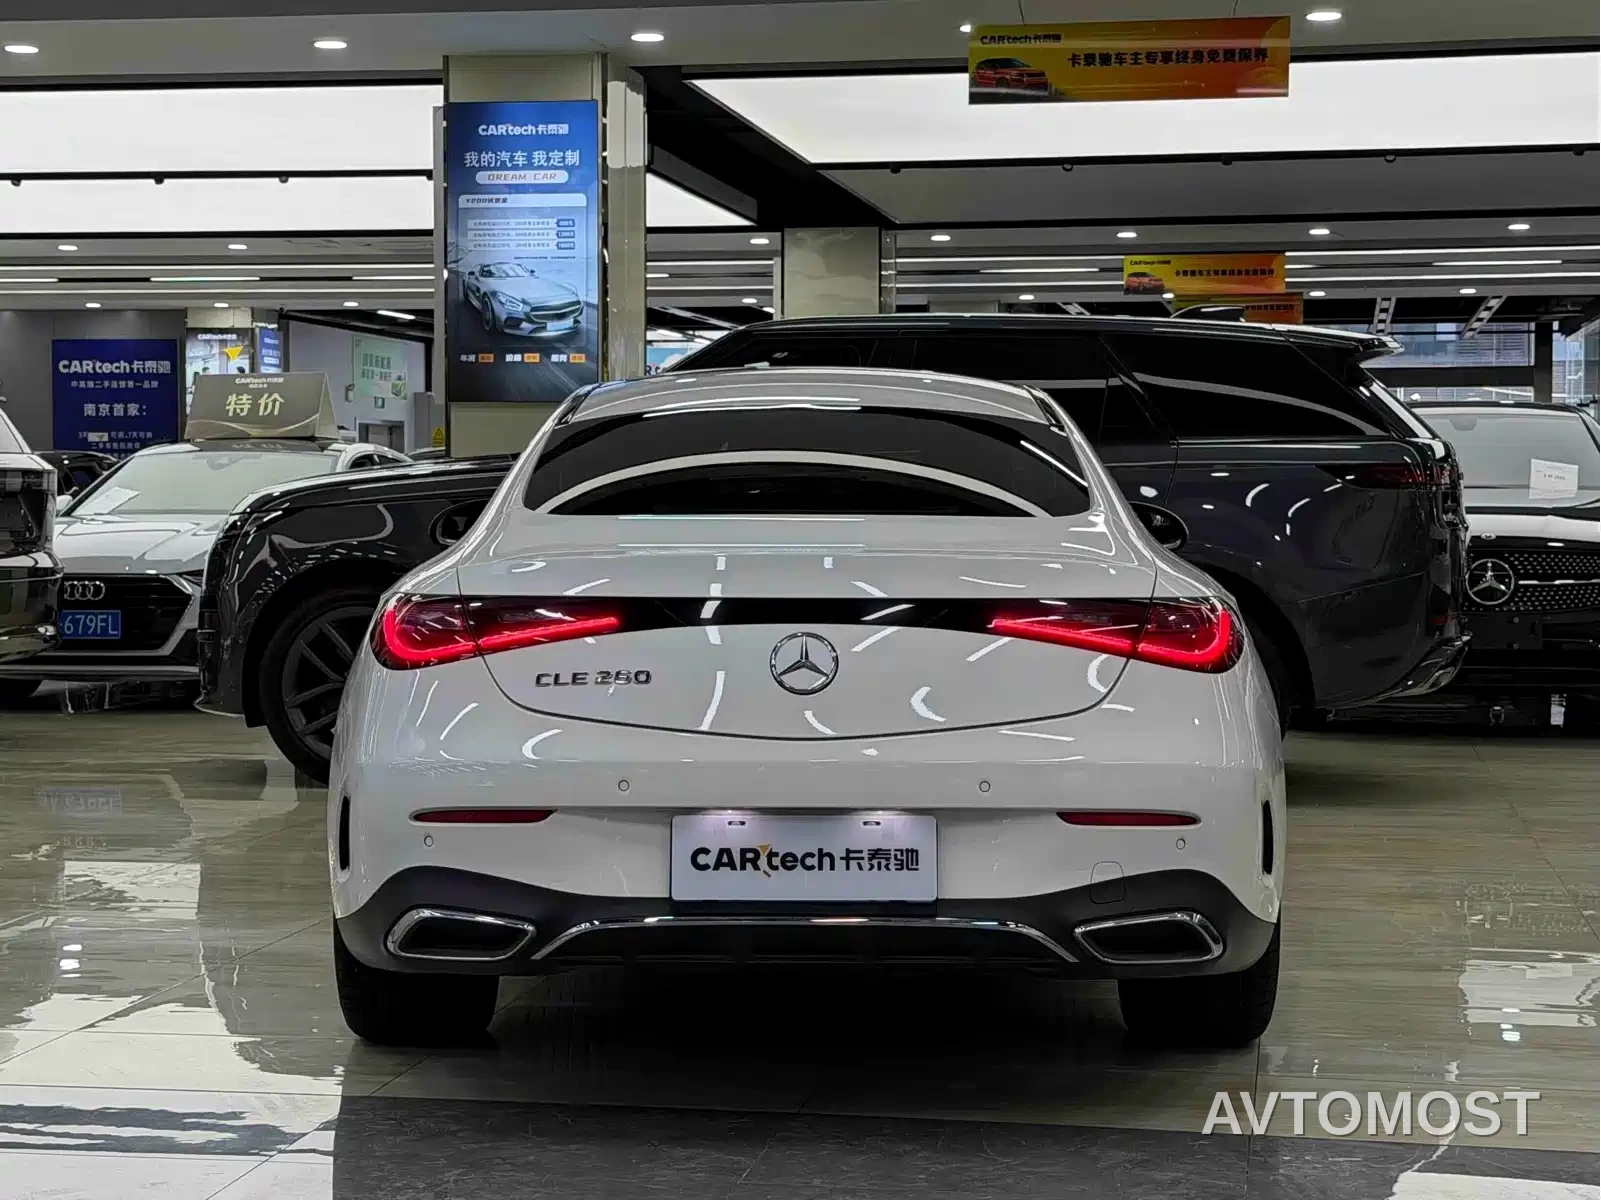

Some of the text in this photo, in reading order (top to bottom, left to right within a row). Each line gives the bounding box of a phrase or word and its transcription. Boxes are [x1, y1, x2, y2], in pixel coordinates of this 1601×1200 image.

[464, 149, 580, 168] 我的汽车 我定制
[487, 173, 557, 181] DREAM CAR
[225, 393, 285, 417] 特价
[535, 669, 652, 688] CLE 260
